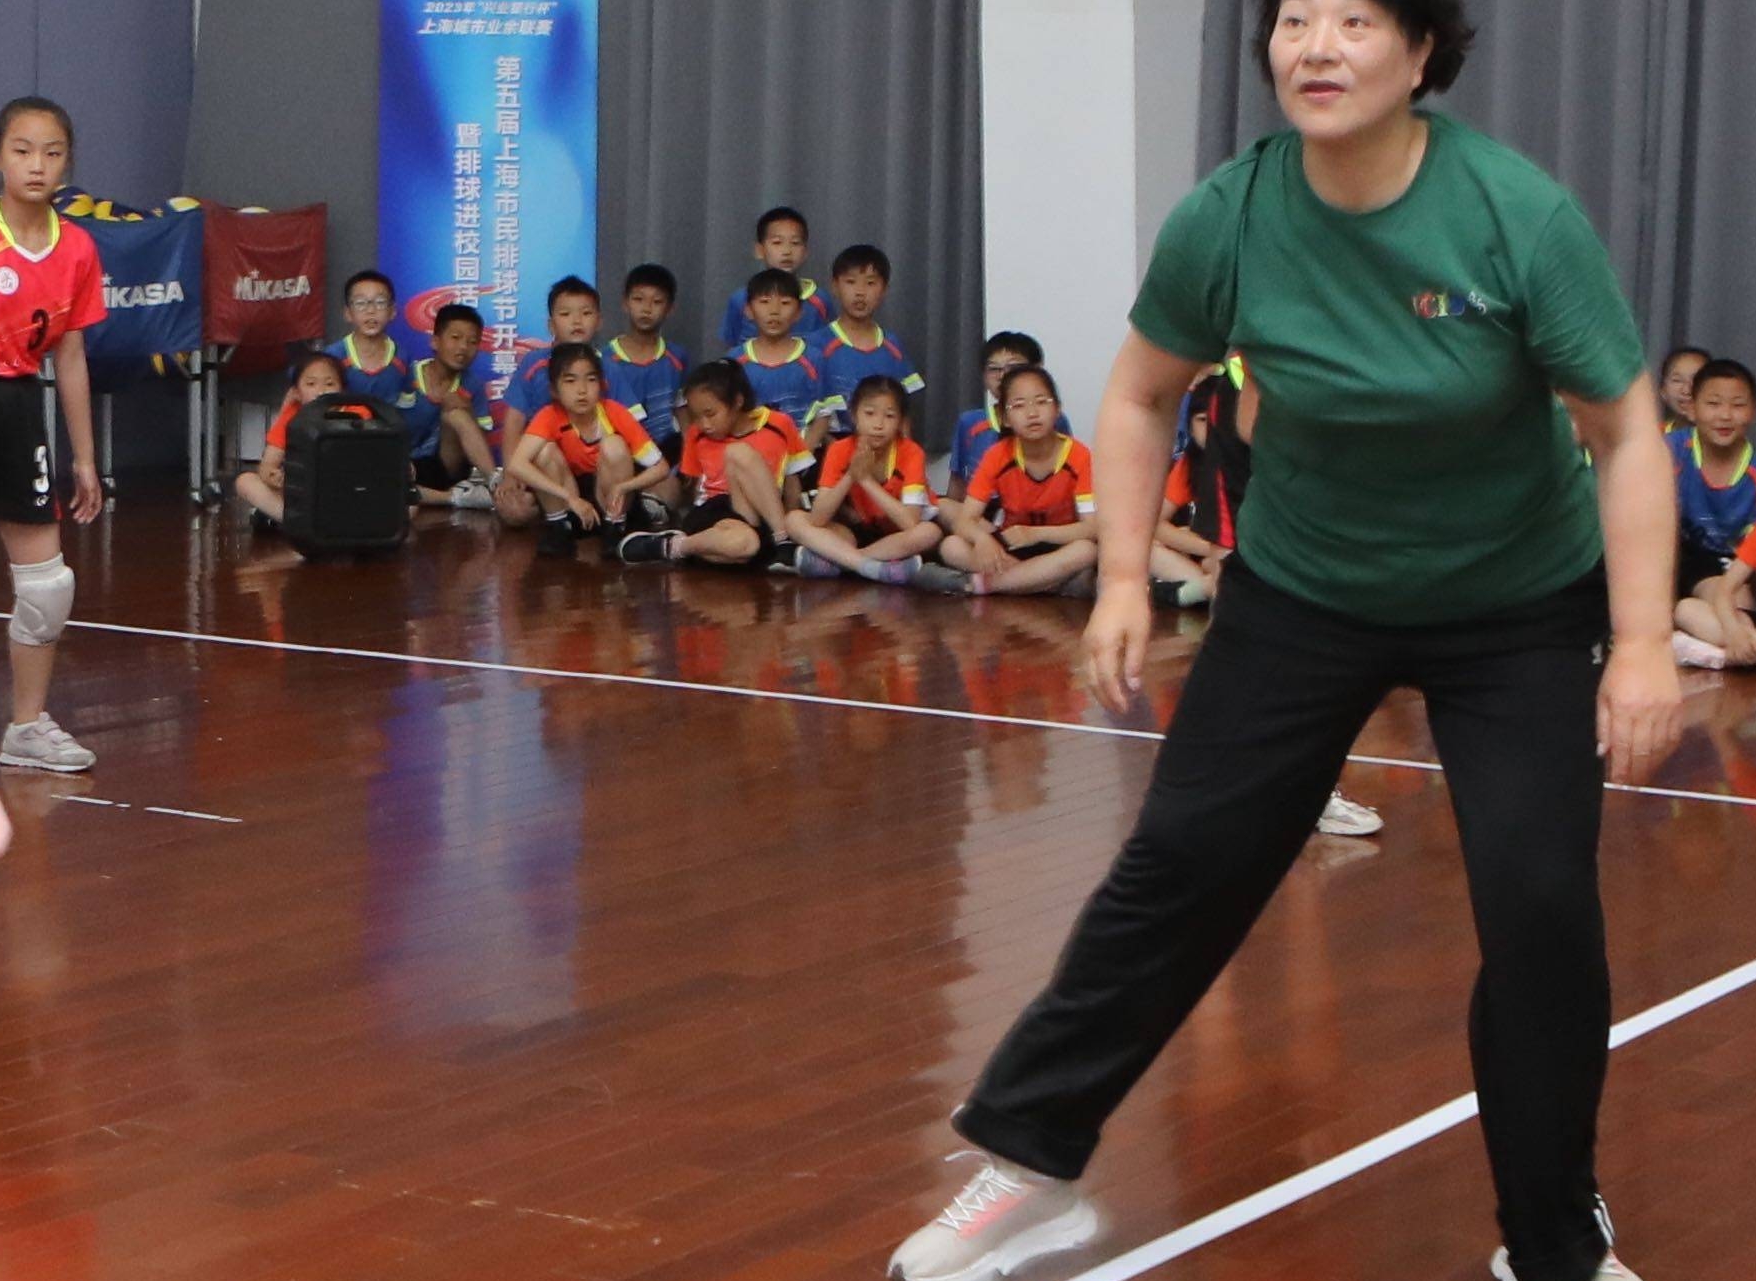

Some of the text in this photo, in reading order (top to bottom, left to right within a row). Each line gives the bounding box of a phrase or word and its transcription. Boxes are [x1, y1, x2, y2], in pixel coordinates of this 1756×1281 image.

[417, 18, 554, 36] 上海城市业余联赛
[102, 280, 185, 309] IKASA
